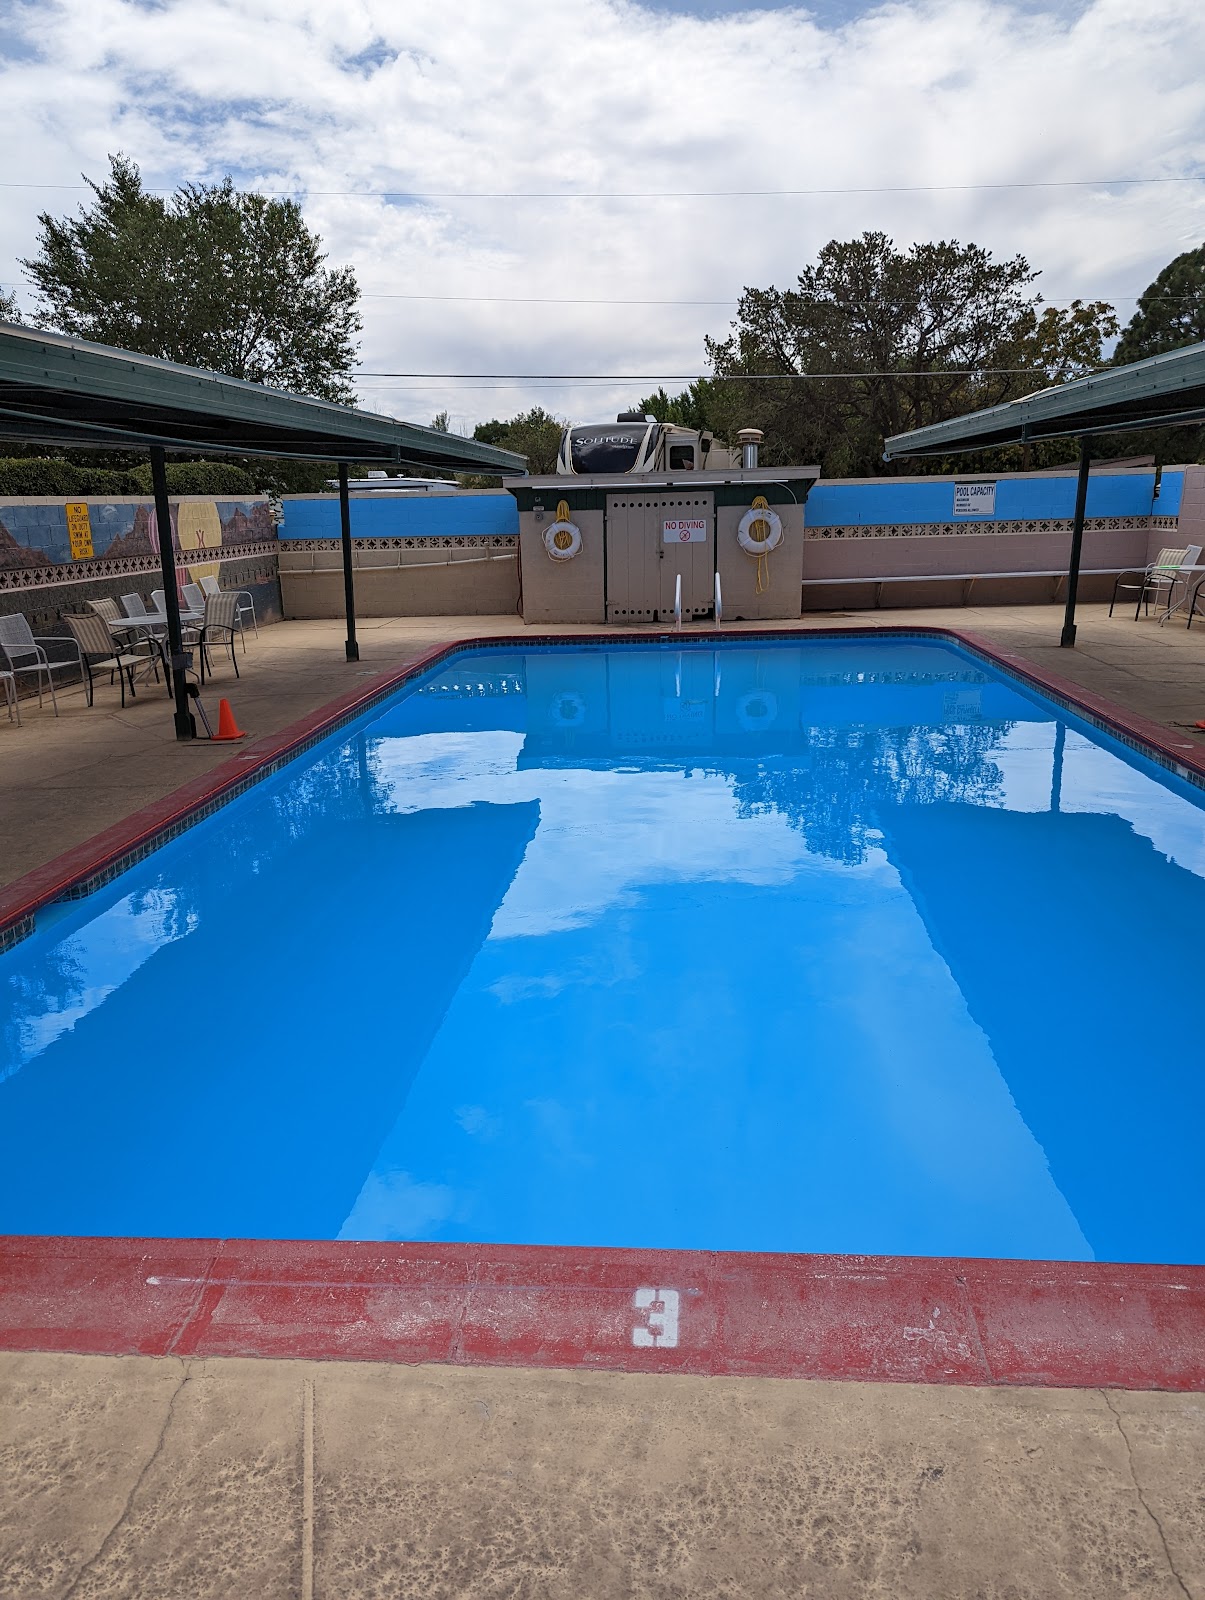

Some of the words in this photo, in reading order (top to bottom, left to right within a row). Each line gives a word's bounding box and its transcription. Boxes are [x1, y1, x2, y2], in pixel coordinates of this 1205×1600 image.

[575, 437, 638, 447] SOLITUDE
[956, 486, 970, 497] POOL
[970, 485, 995, 496] CAPACITY
[73, 506, 82, 514] NO
[665, 521, 677, 530] NO
[678, 520, 705, 530] DIVING
[632, 1288, 679, 1347] 3
